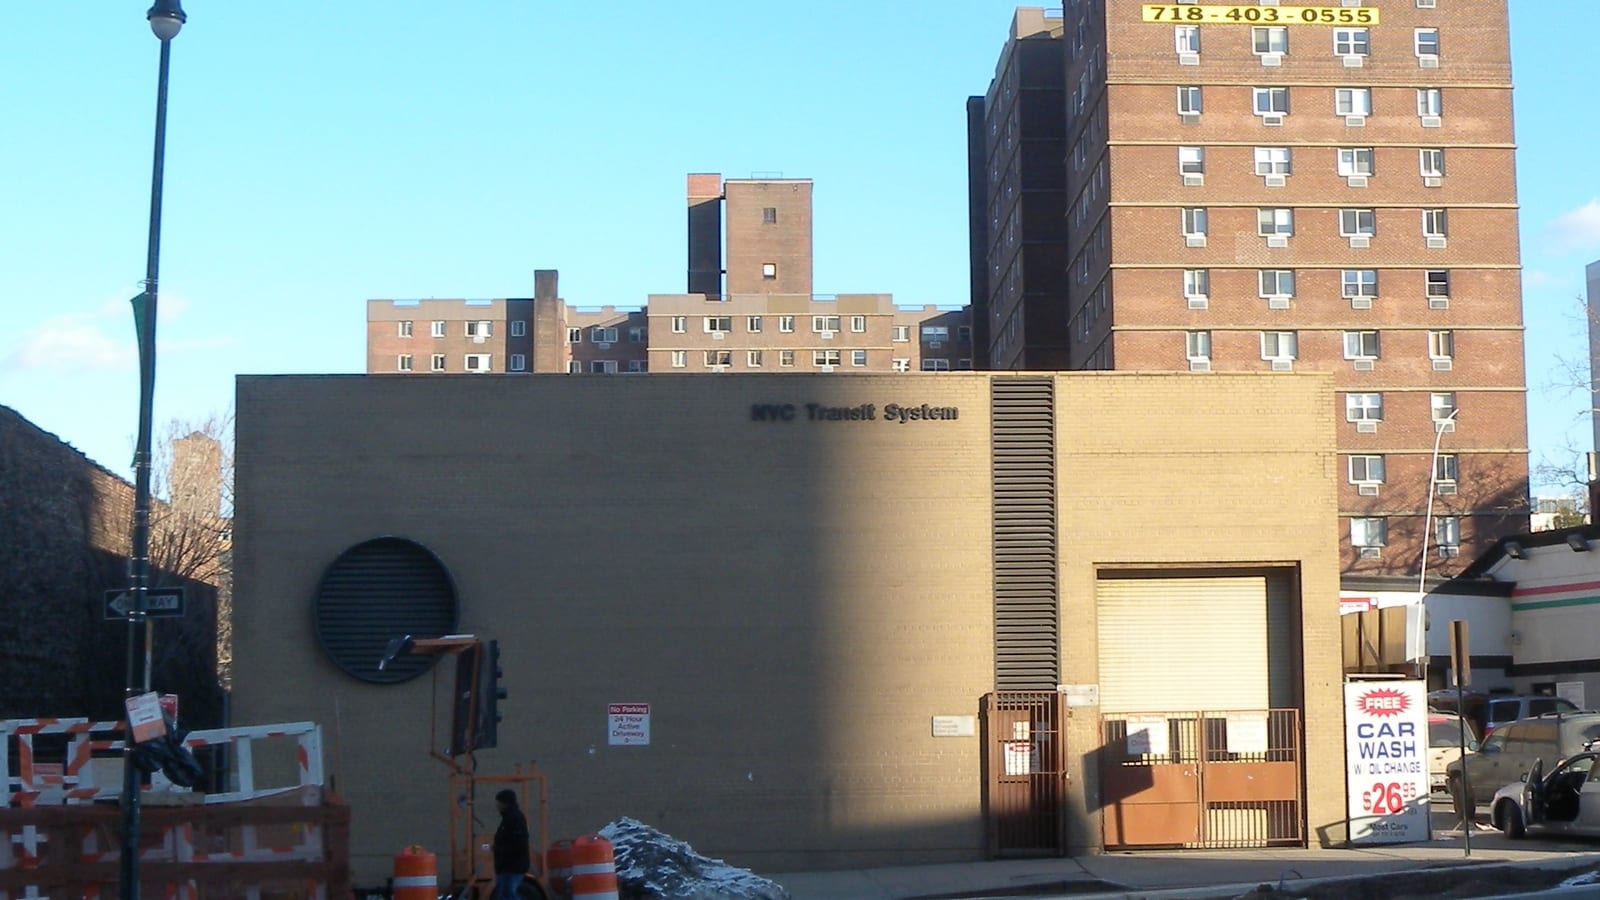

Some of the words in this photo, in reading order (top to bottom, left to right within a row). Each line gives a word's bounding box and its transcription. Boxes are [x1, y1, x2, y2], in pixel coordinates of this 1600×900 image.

[751, 403, 796, 421] NYC
[805, 403, 876, 421] Transit
[884, 403, 959, 424] System
[150, 596, 174, 608] WAY
[622, 706, 647, 714] Parking
[1365, 697, 1401, 710] FREE
[1357, 721, 1415, 739] CAR
[1358, 740, 1416, 759] WASH
[1369, 763, 1382, 775] OIL
[1384, 761, 1421, 774] CHANGE
[1369, 823, 1389, 831] Most
[1391, 822, 1408, 831] Cars
